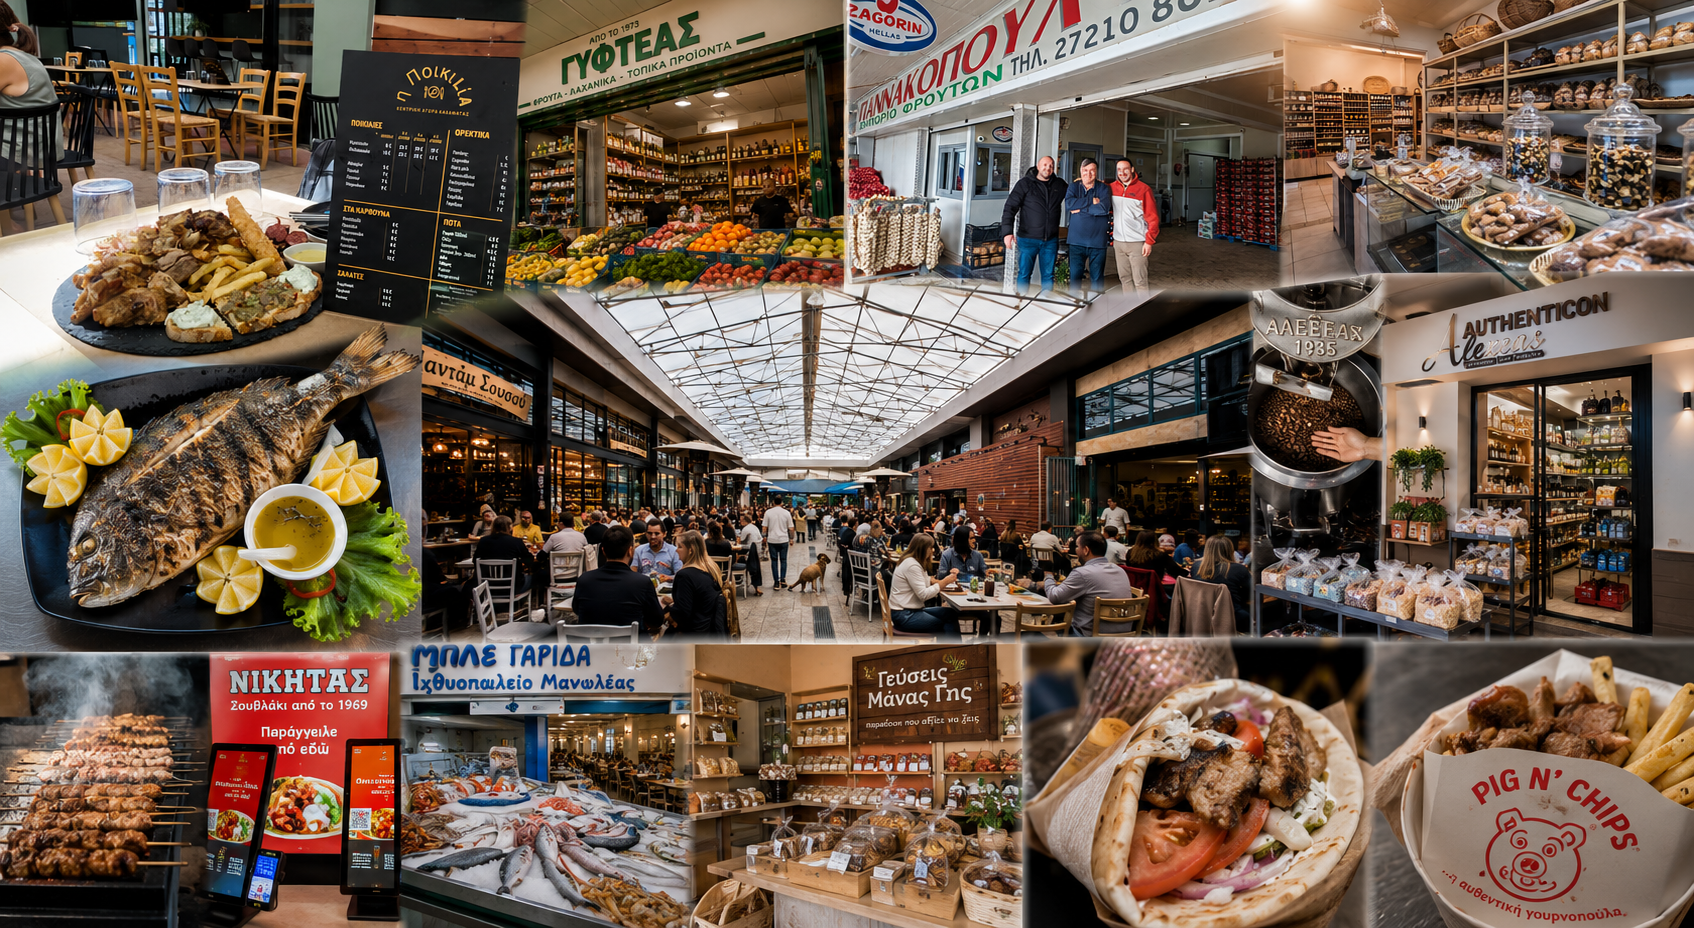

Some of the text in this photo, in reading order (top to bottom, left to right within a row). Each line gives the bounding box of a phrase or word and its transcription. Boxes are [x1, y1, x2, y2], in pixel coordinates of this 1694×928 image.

[589, 20, 639, 44] ΑΠΟ ΤΟ 1973
[850, 4, 922, 34] ZAGORIN
[561, 10, 700, 85] ΓΥΦΤΕΑΣ
[869, 28, 900, 40] HELLAS
[1010, 48, 1048, 76] ΤΗΛ.
[1055, 7, 1139, 60] 27210
[570, 76, 616, 95] ΛΑΧΑΝΙΚΑ
[627, 60, 666, 78] ΤΟΠΙΚΑ
[903, 64, 1002, 113] ΦΡΟΥΤΩΝ
[1462, 291, 1610, 339] AUTHENTICON
[422, 350, 476, 388] αντάμ
[229, 668, 369, 694] ΝΙΚΗΤΑΣ
[540, 674, 635, 692] Μανωλέας
[878, 667, 948, 688] Γεύσεις
[230, 700, 368, 712] Σουβλάκι από το 1969
[868, 684, 972, 708] Μάνας Γης
[261, 725, 337, 740] Παράγγειλε
[278, 742, 295, 755] πό
[1471, 767, 1638, 850] PIG N' CHIPS
[1459, 881, 1522, 918] αυθεντική
